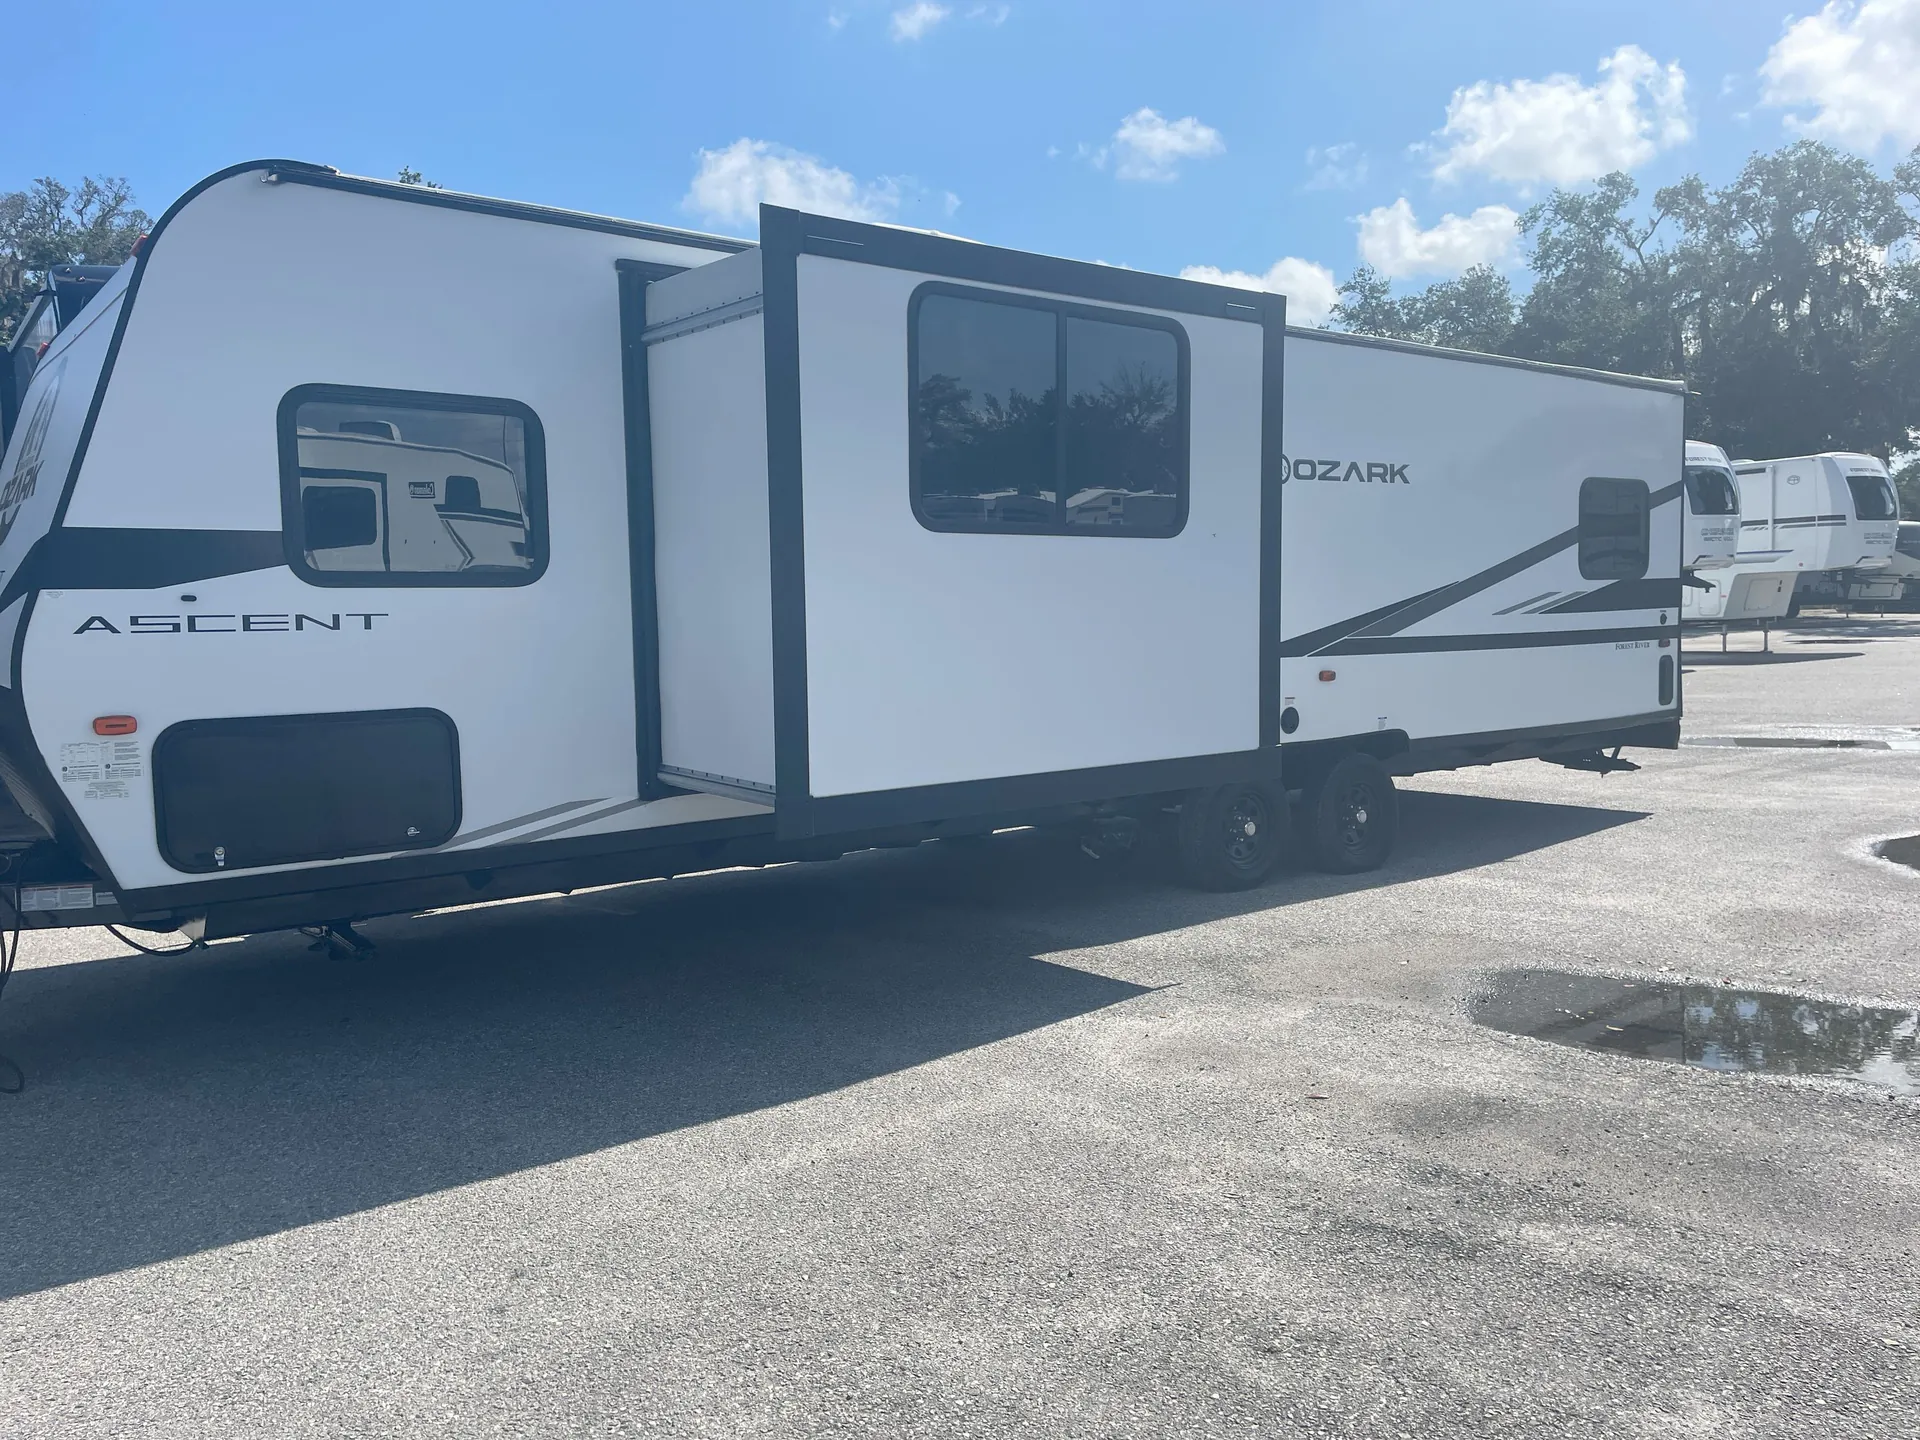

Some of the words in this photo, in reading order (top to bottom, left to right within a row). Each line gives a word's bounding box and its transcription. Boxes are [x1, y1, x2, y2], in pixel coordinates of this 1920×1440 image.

[1292, 458, 1411, 485] OZARK
[73, 613, 389, 635] ASCENT
[1615, 642, 1633, 650] FOREST
[1634, 641, 1650, 649] RIVER
